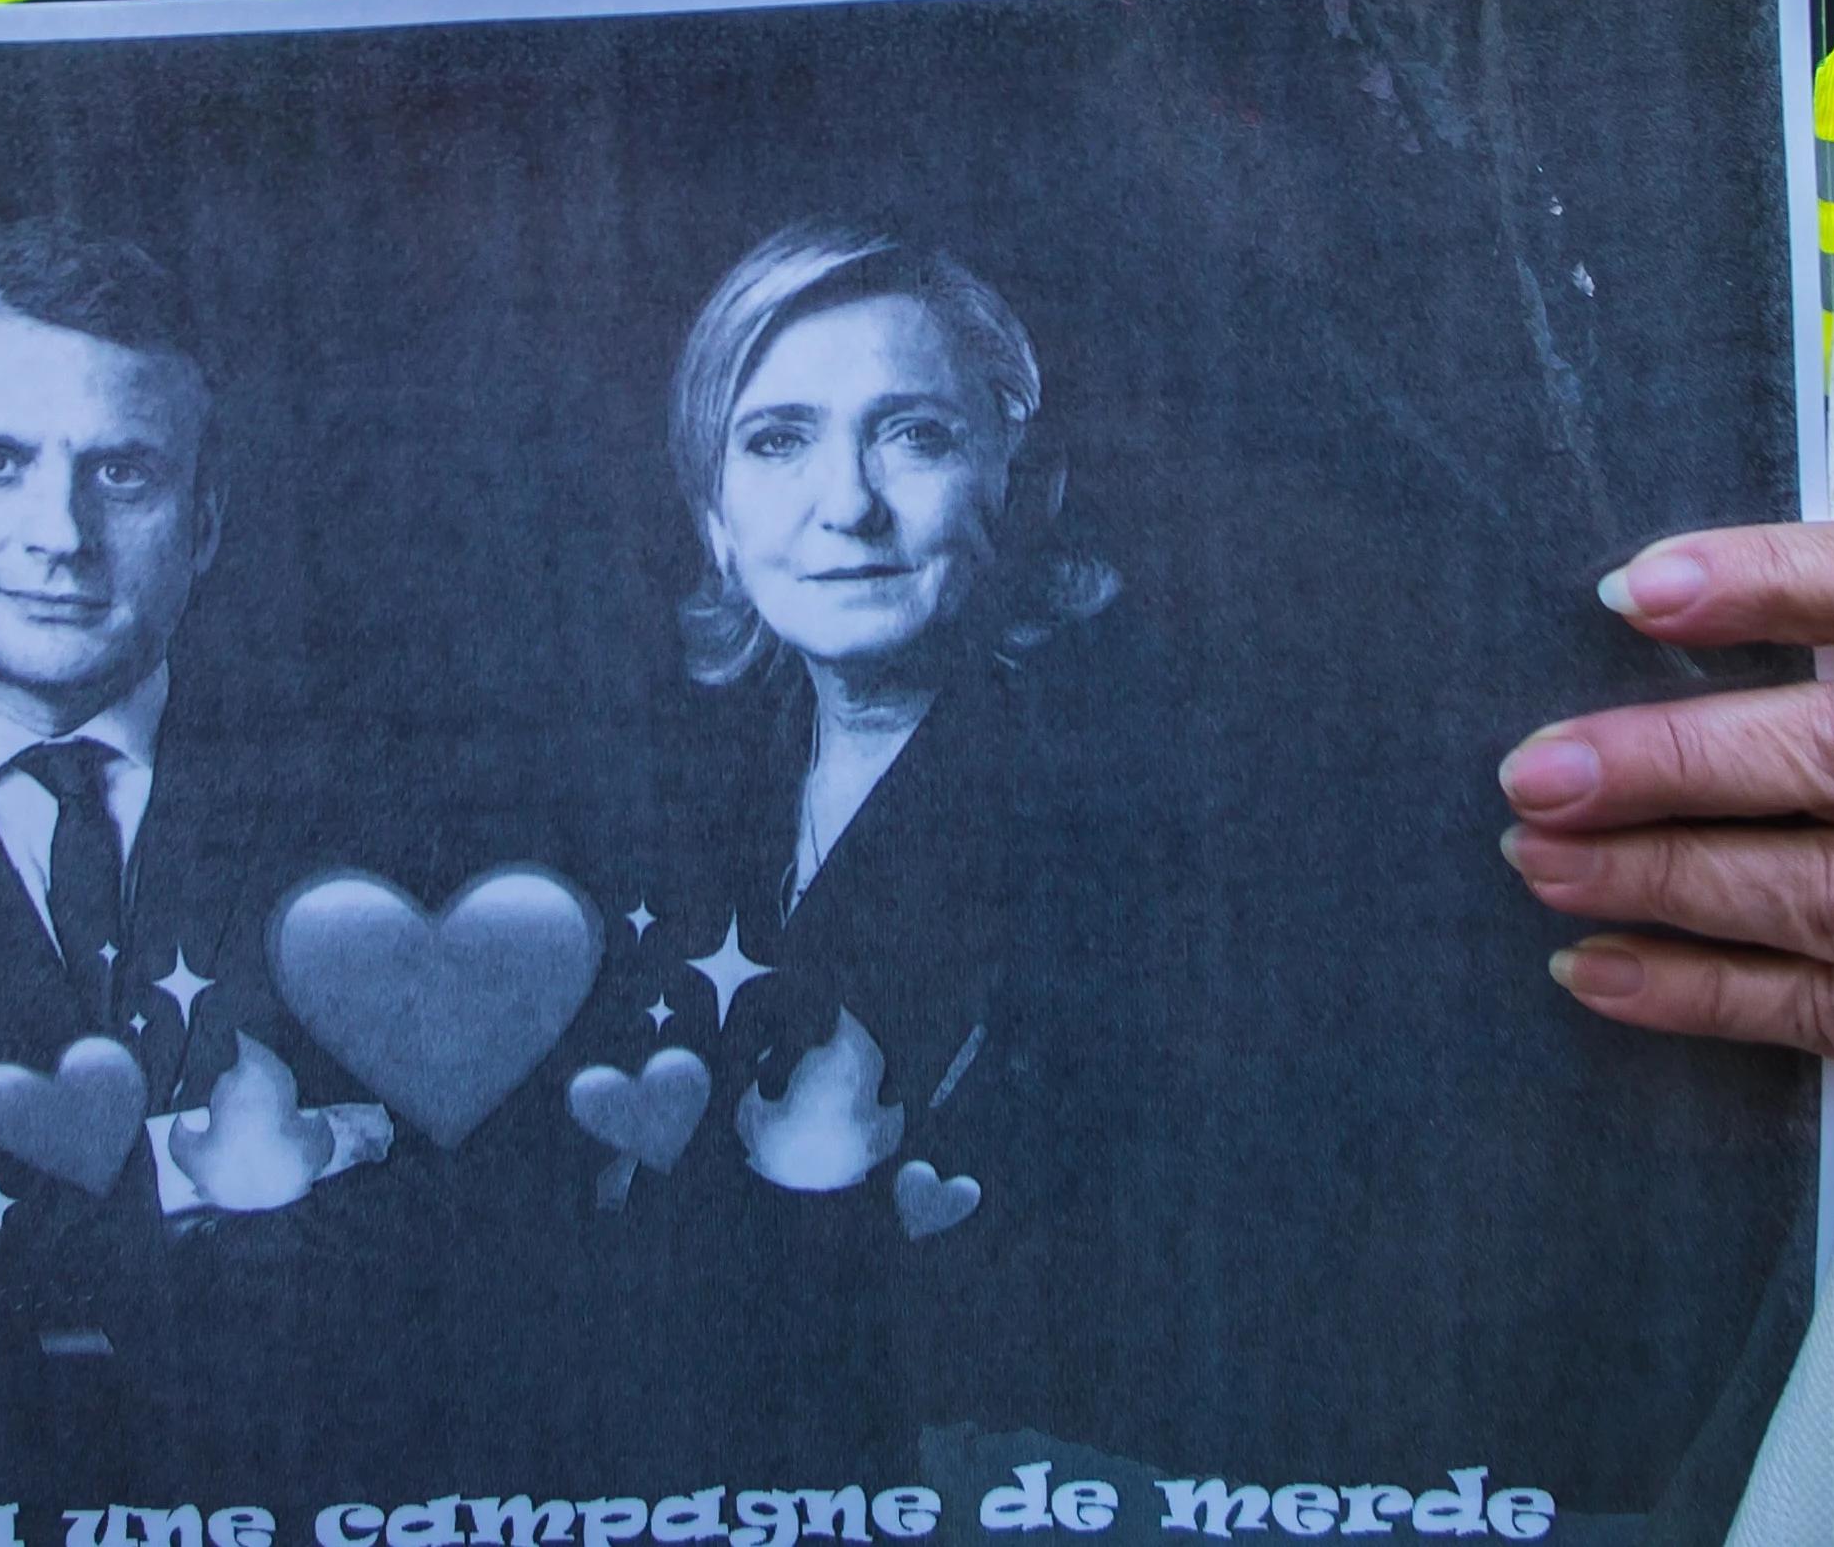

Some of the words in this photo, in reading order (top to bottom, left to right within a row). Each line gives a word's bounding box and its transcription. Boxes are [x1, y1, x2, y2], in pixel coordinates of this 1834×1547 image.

[62, 1504, 276, 1547] une
[314, 1485, 942, 1547] campagne
[979, 1461, 1120, 1533] de
[1153, 1467, 1556, 1539] merde
